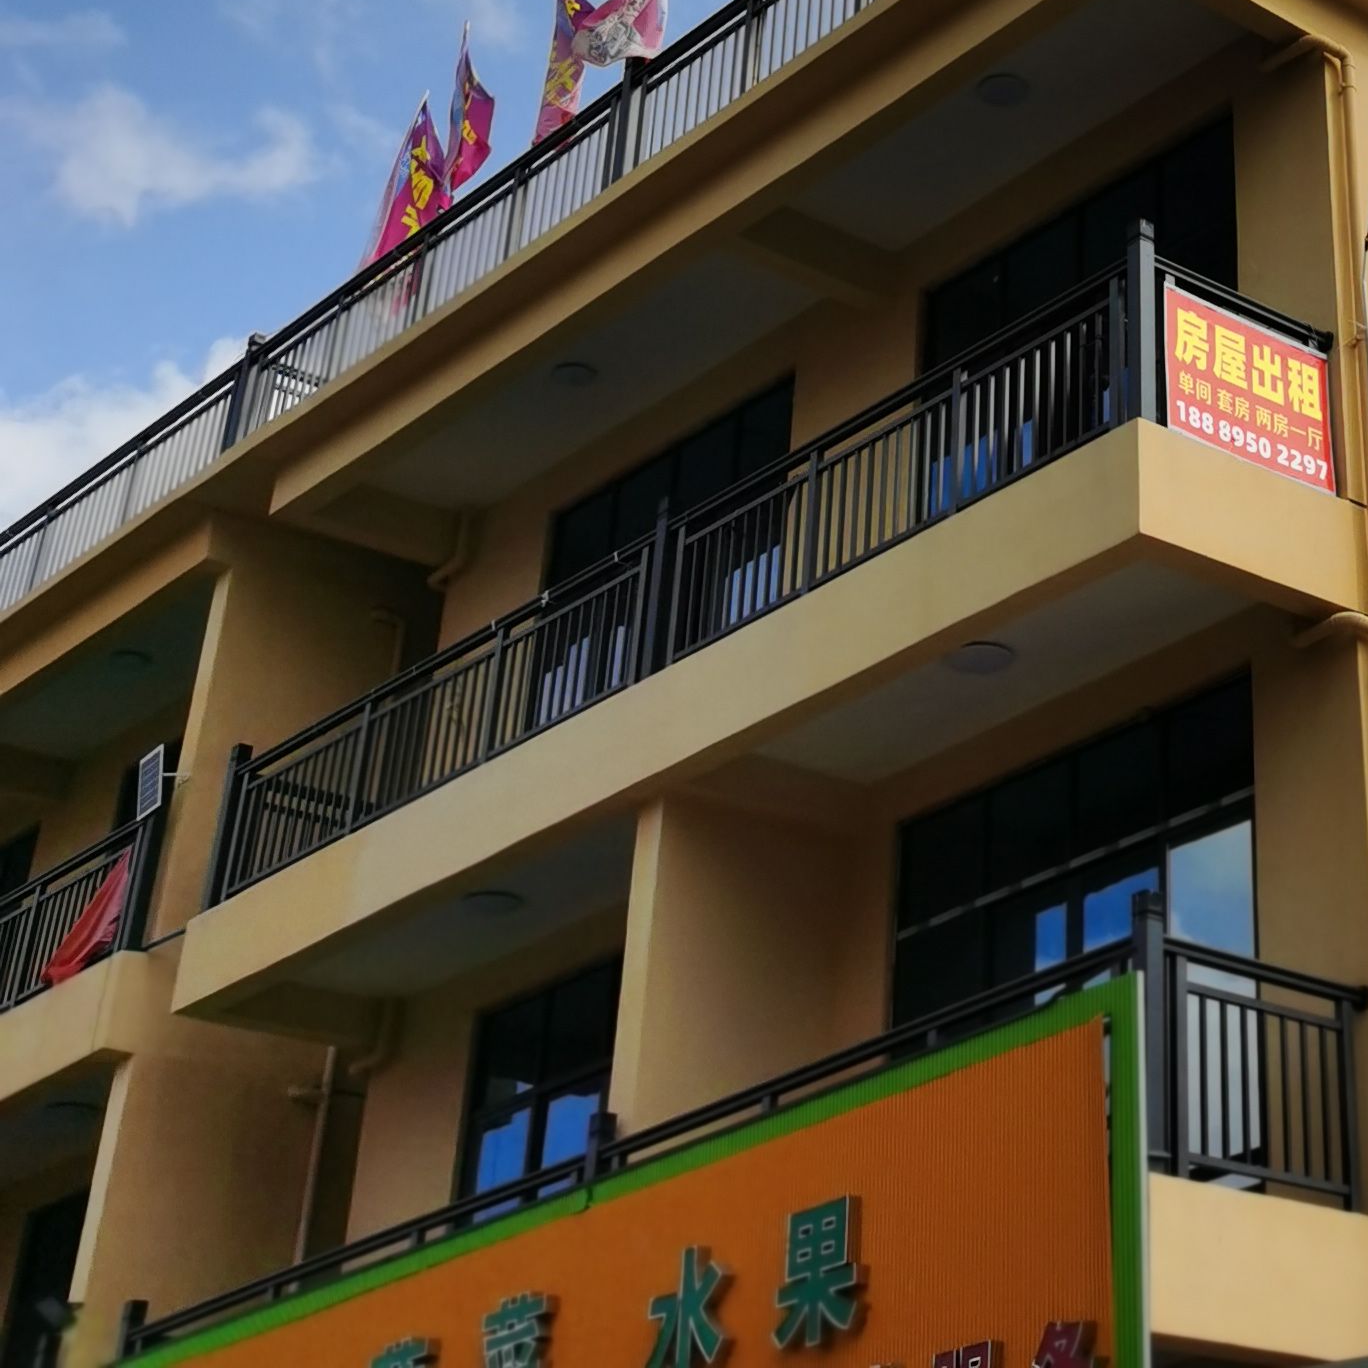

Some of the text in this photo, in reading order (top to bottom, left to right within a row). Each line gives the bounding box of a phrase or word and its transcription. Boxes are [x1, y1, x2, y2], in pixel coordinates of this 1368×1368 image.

[1175, 308, 1322, 421] 房屋出租
[1176, 400, 1328, 480] 188 8950 2297
[1178, 371, 1323, 451] 单间 套房 两房一厅
